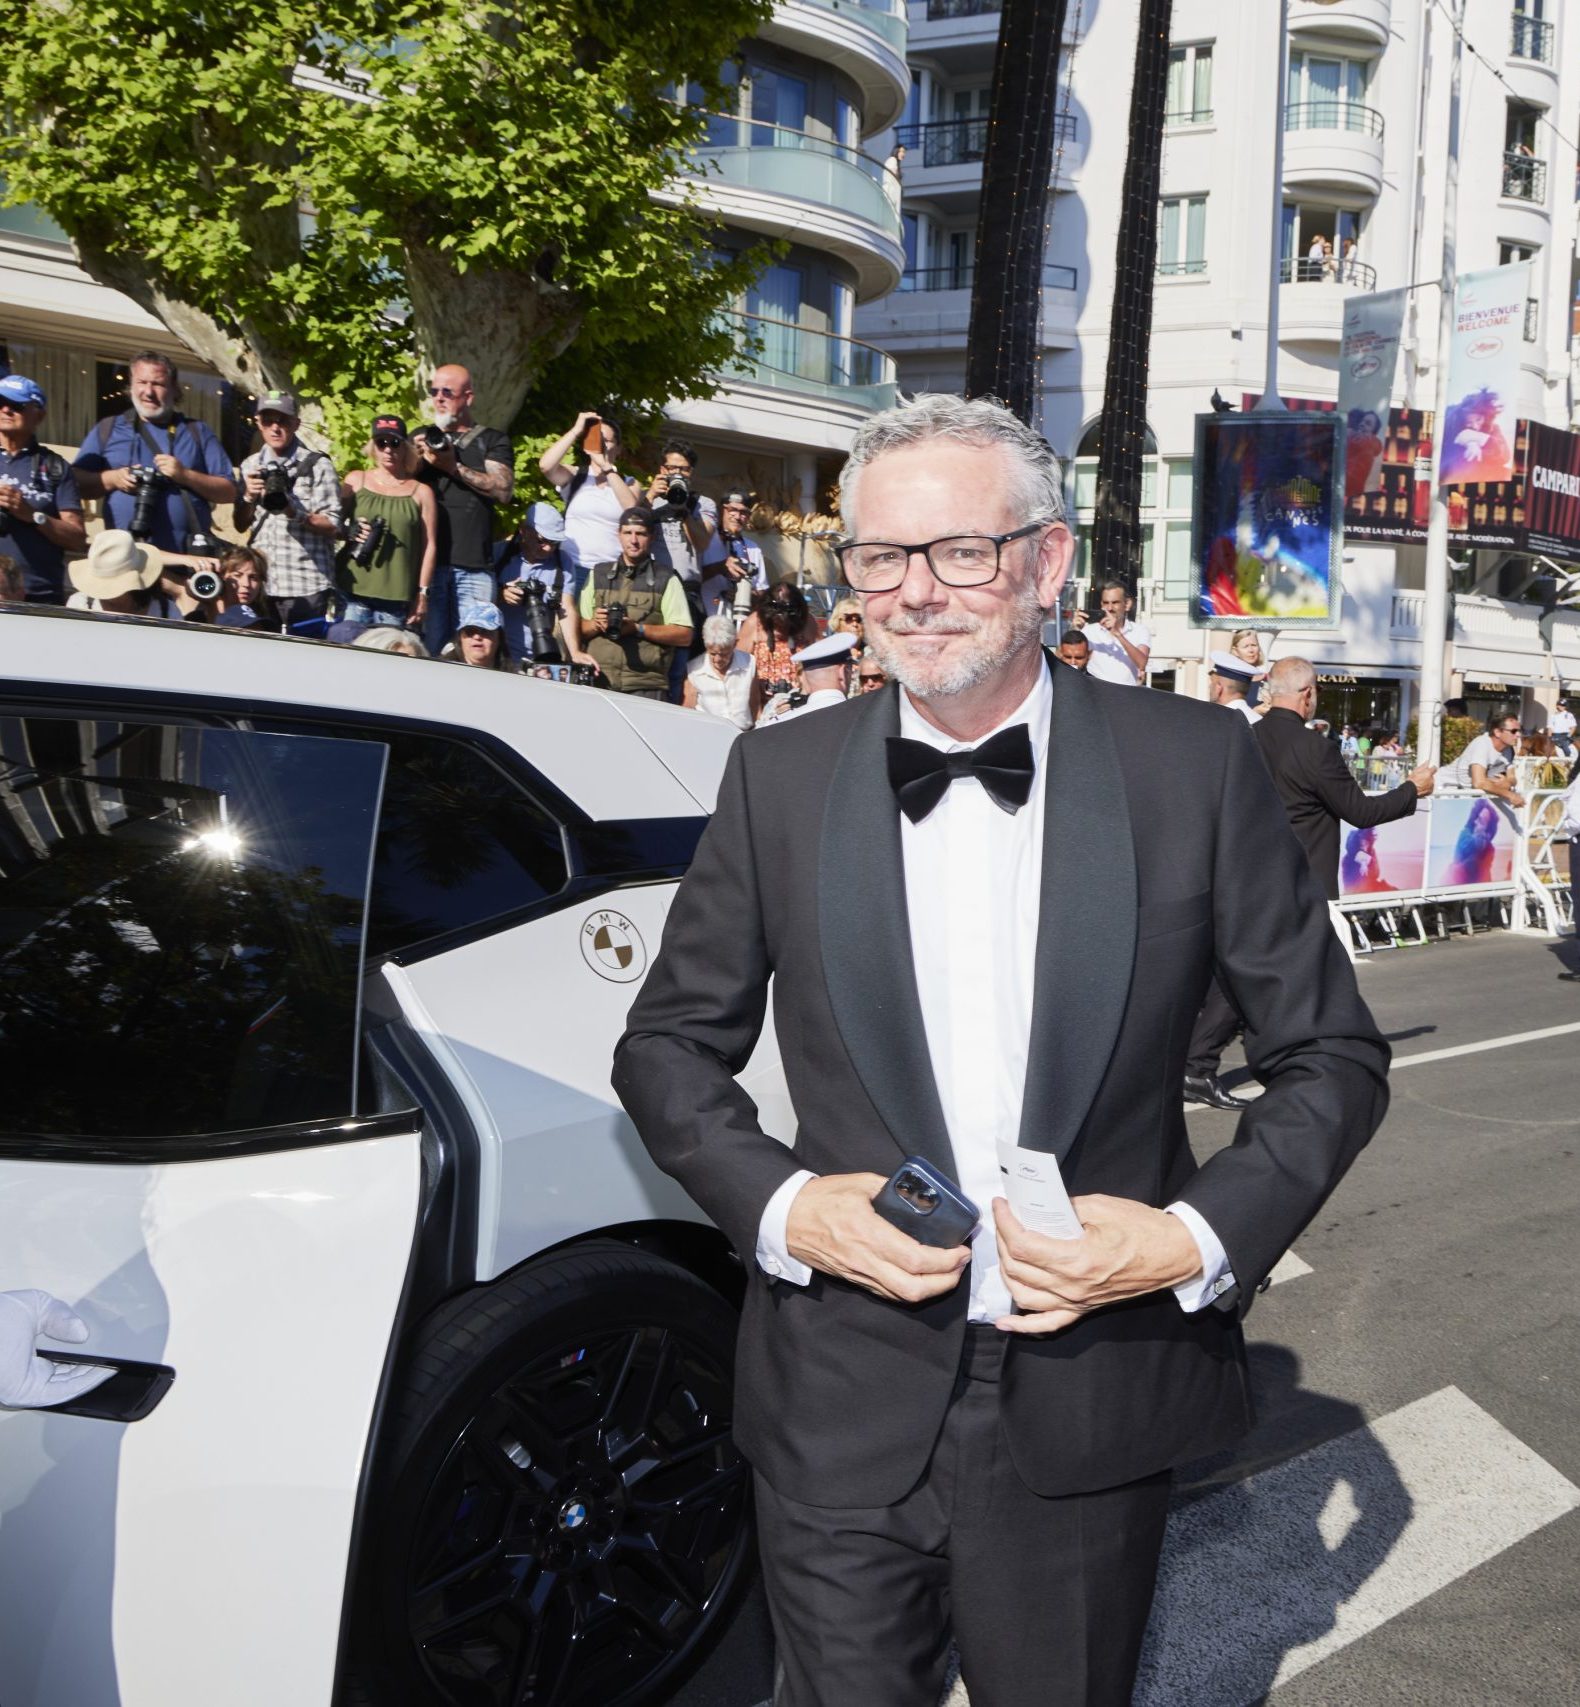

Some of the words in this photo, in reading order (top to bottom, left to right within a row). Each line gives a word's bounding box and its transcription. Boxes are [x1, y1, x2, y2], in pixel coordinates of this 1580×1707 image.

[1458, 303, 1520, 323] BIENVENUE
[1457, 316, 1511, 332] WELCOME
[1532, 465, 1580, 497] CAMPARI
[1353, 526, 1371, 534] POUR
[1372, 527, 1381, 535] LA
[1317, 673, 1357, 684] RADA
